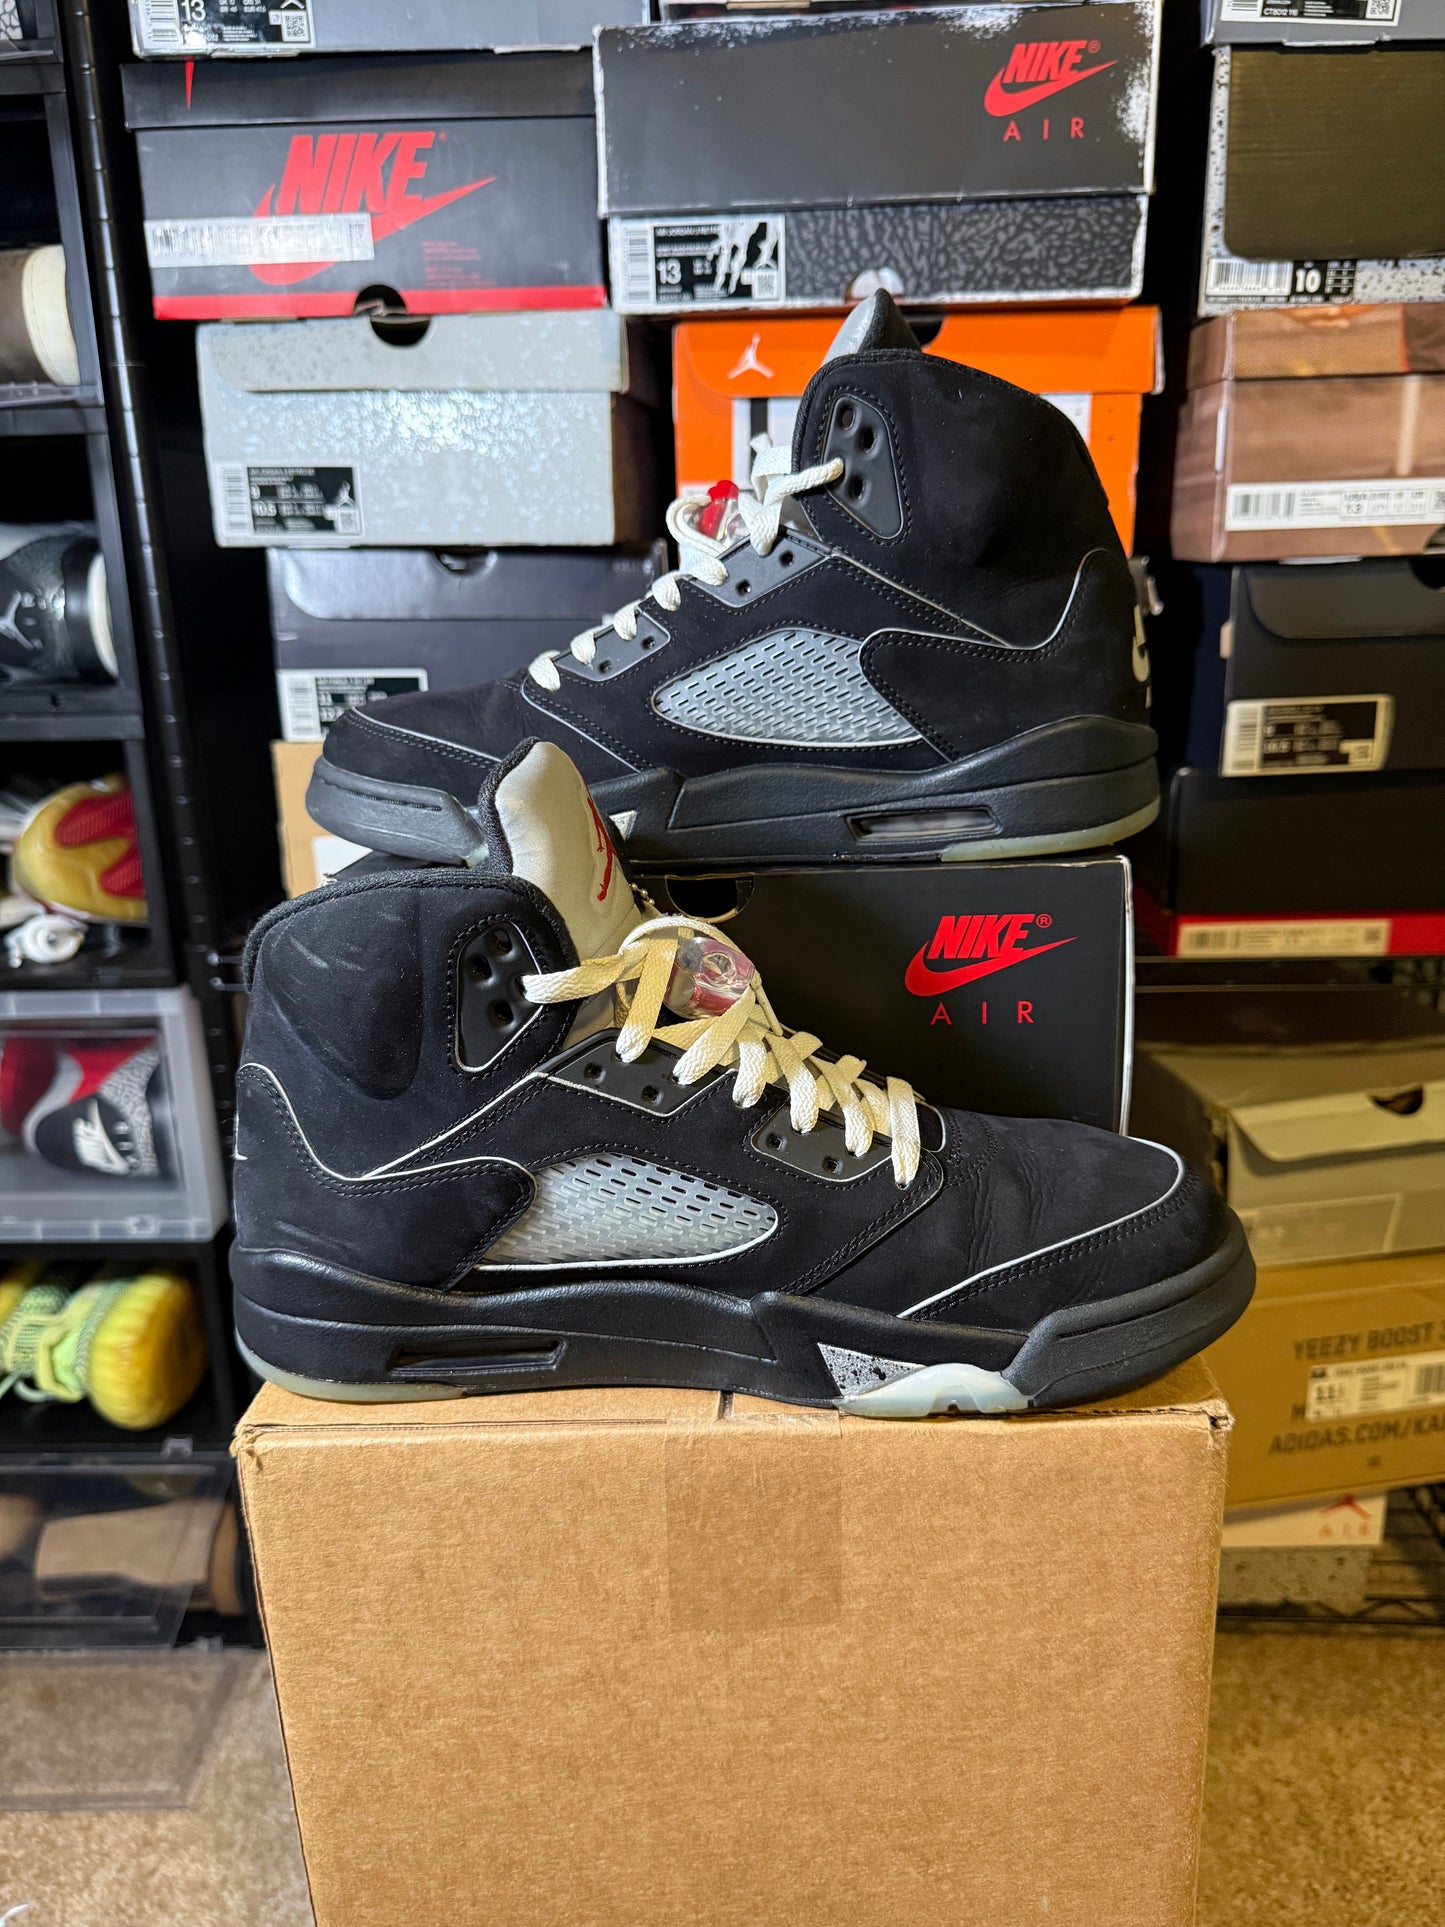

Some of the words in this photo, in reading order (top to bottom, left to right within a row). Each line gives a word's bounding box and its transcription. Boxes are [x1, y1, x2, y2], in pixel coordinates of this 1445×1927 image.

[180, 0, 207, 22] 13
[1002, 39, 1088, 84] NIKE
[1002, 116, 1085, 142] AIR
[275, 130, 436, 215] NIKE
[656, 257, 682, 285] 13
[1295, 268, 1321, 294] 10
[926, 913, 1036, 960] NIKE
[930, 1000, 1035, 1025] AIR
[1293, 1333, 1359, 1360] YEEZY
[1366, 1321, 1433, 1350] BOOST
